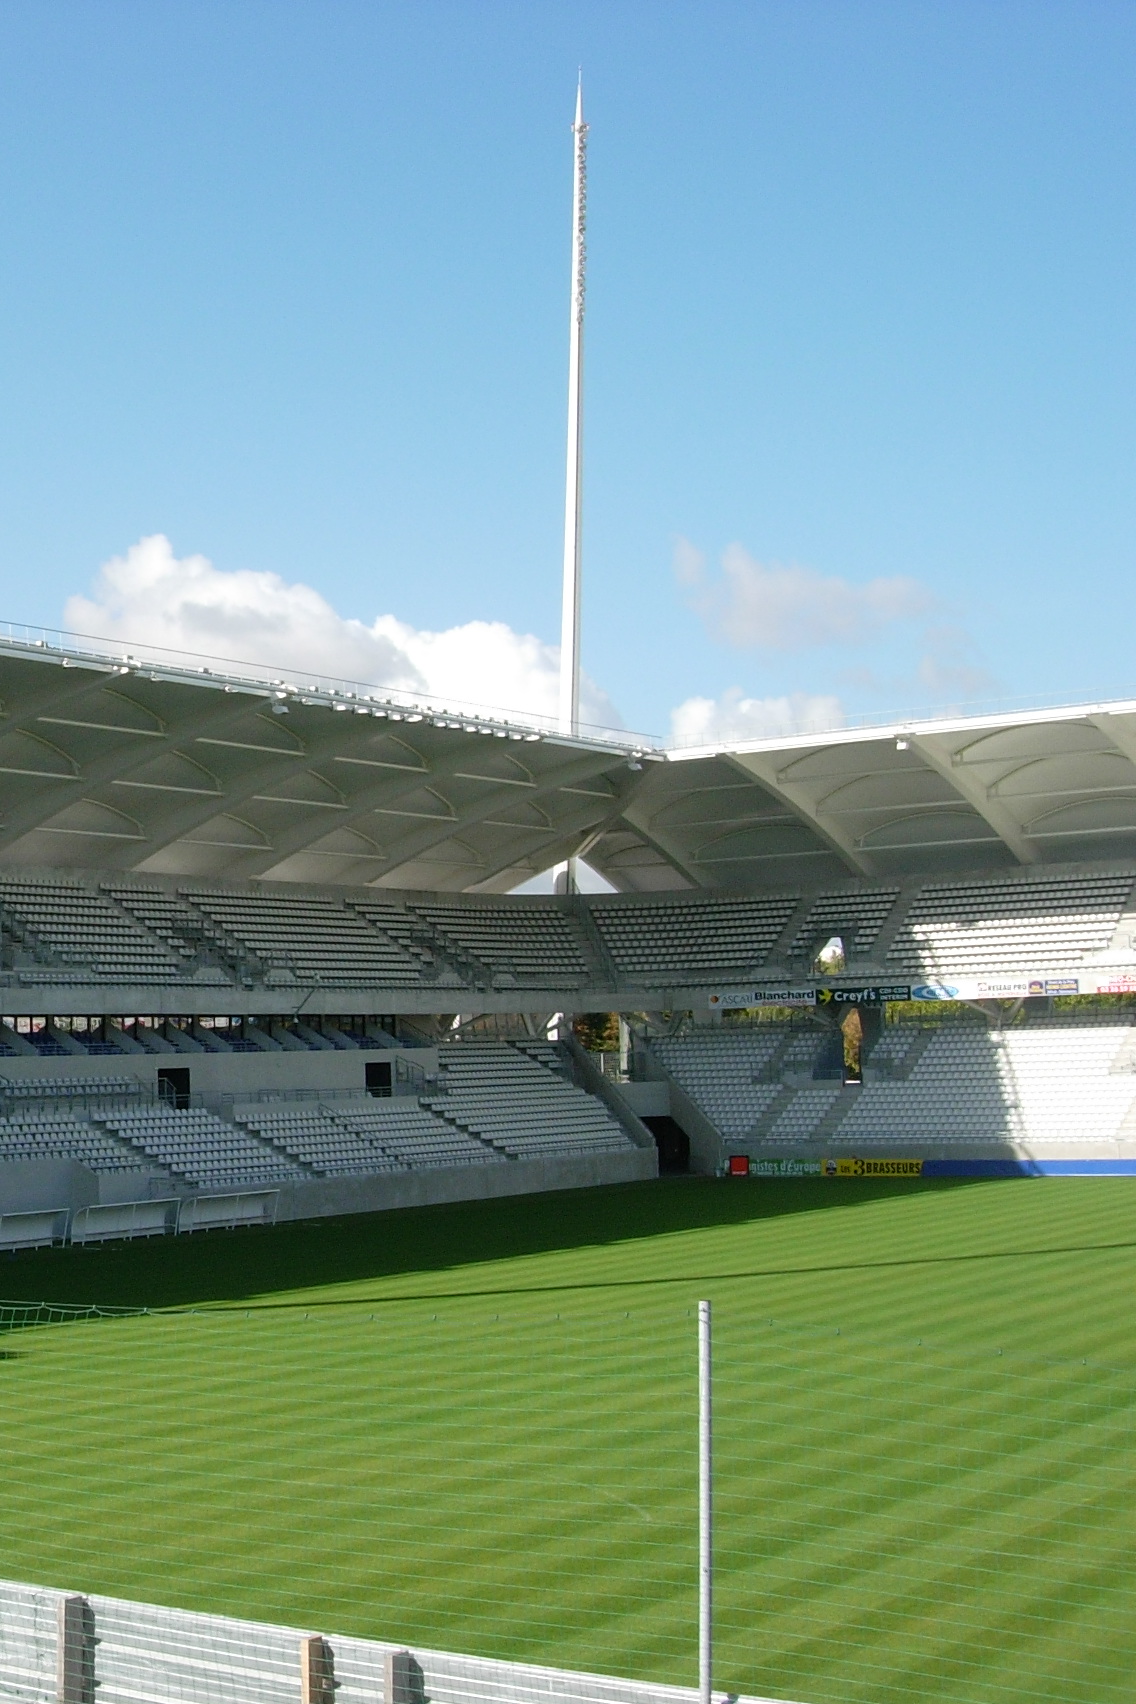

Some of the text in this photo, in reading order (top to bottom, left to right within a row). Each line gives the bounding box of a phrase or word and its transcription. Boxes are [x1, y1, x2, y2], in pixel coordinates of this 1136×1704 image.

[754, 990, 814, 1001] Blanchard
[834, 987, 876, 1003] Creyf's
[780, 1159, 821, 1174] d'Europe
[853, 1159, 865, 1176] 3
[866, 1162, 920, 1174] BRASSEURS
